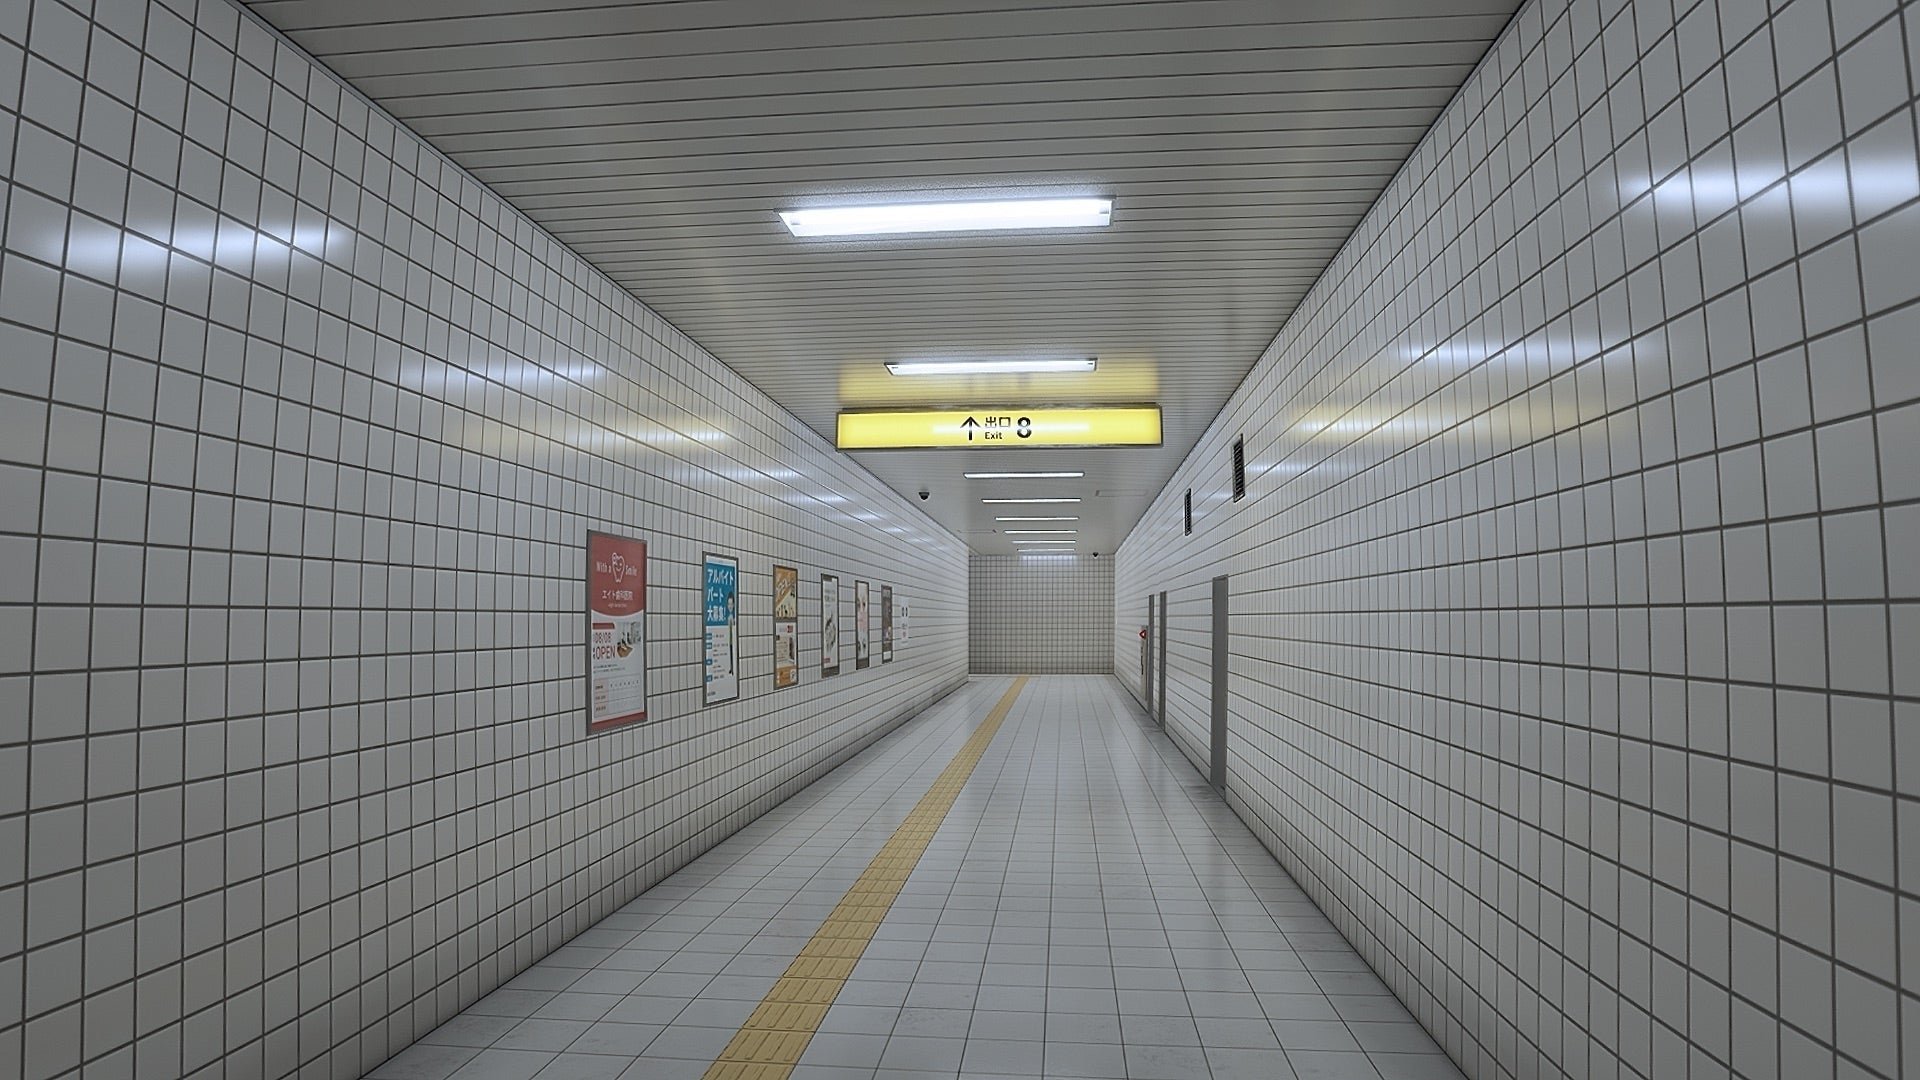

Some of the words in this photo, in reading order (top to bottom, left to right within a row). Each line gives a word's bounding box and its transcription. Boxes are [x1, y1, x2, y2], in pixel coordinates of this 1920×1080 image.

[985, 416, 1011, 428] 出口
[1017, 416, 1032, 439] 8
[985, 431, 1002, 440] Exit
[707, 568, 734, 586] アルバイト
[707, 586, 724, 603] パート
[596, 645, 616, 660] OPEN
